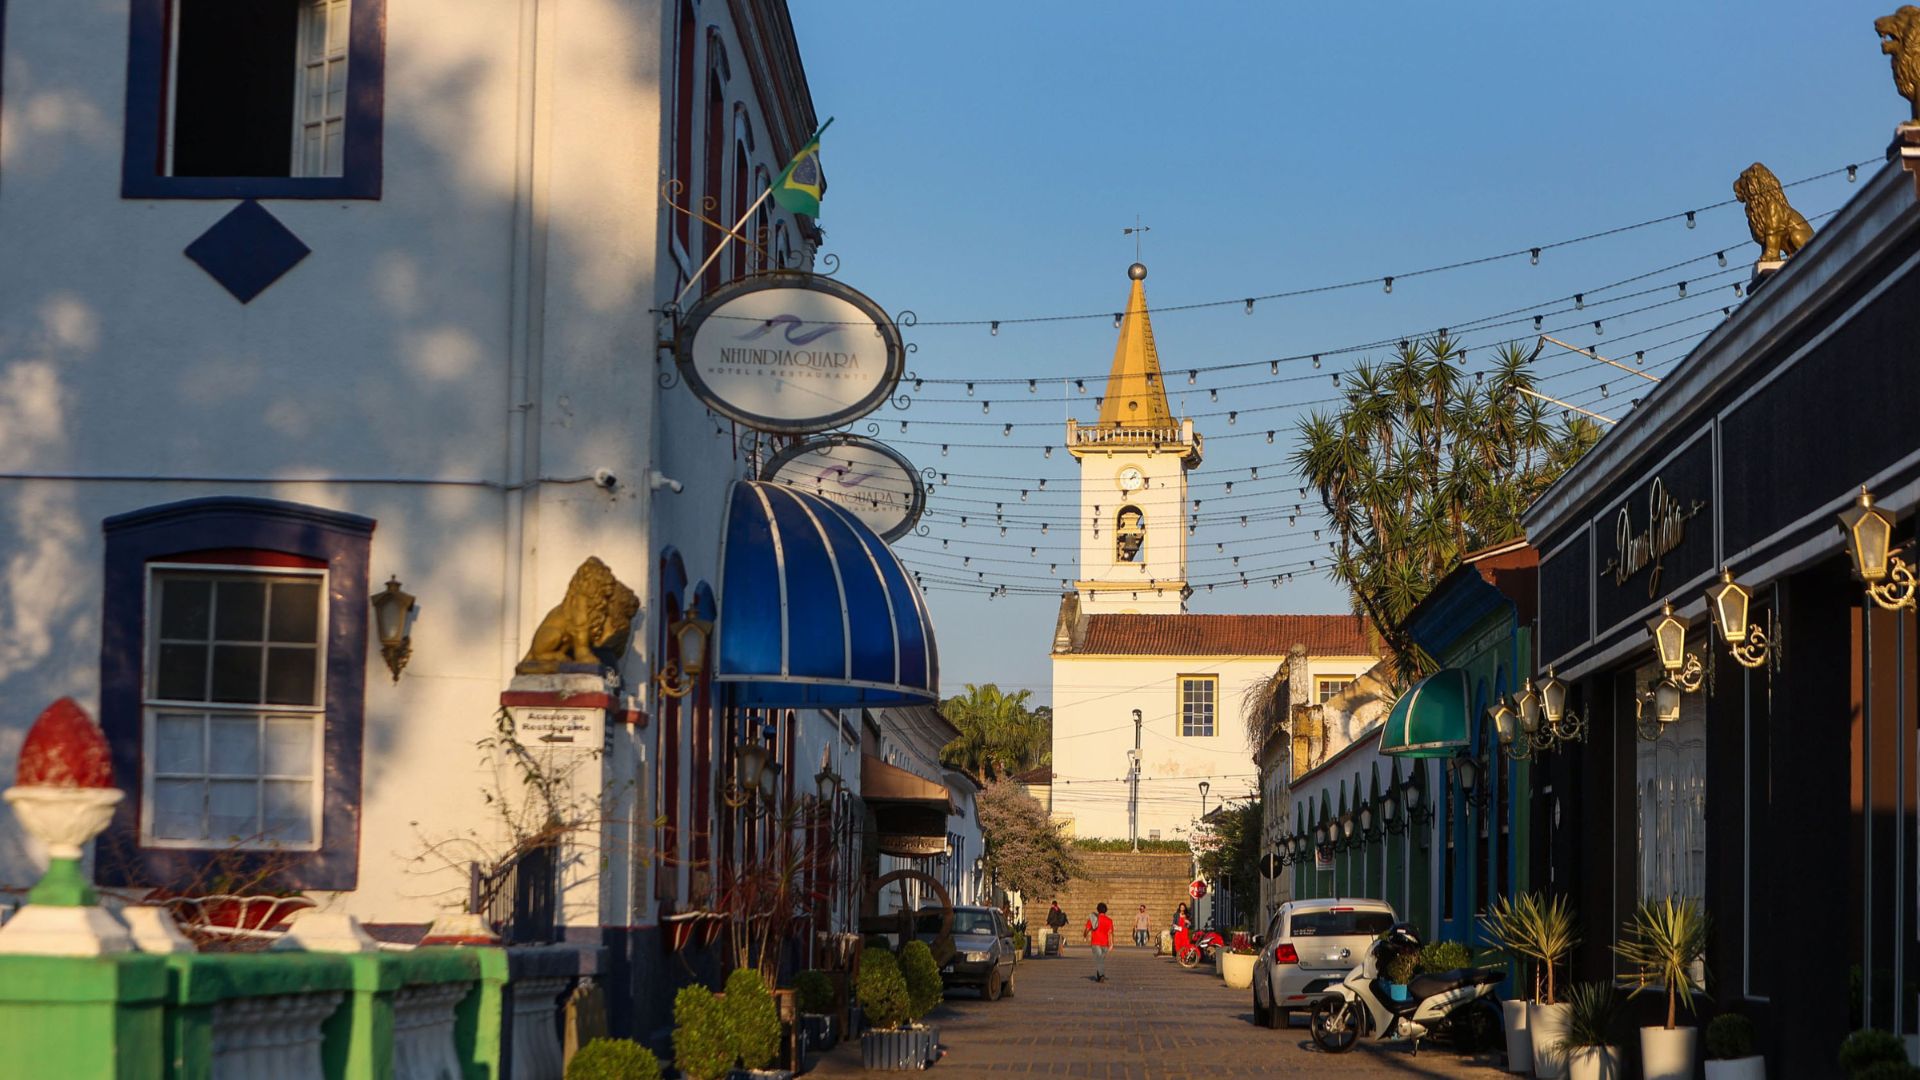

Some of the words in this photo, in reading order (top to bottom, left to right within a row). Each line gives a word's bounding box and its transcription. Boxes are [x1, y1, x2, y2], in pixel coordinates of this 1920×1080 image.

[720, 347, 860, 371] NHUNDIAQUARA
[708, 367, 750, 376] HOTEL
[770, 369, 868, 380] RESTAURANTE
